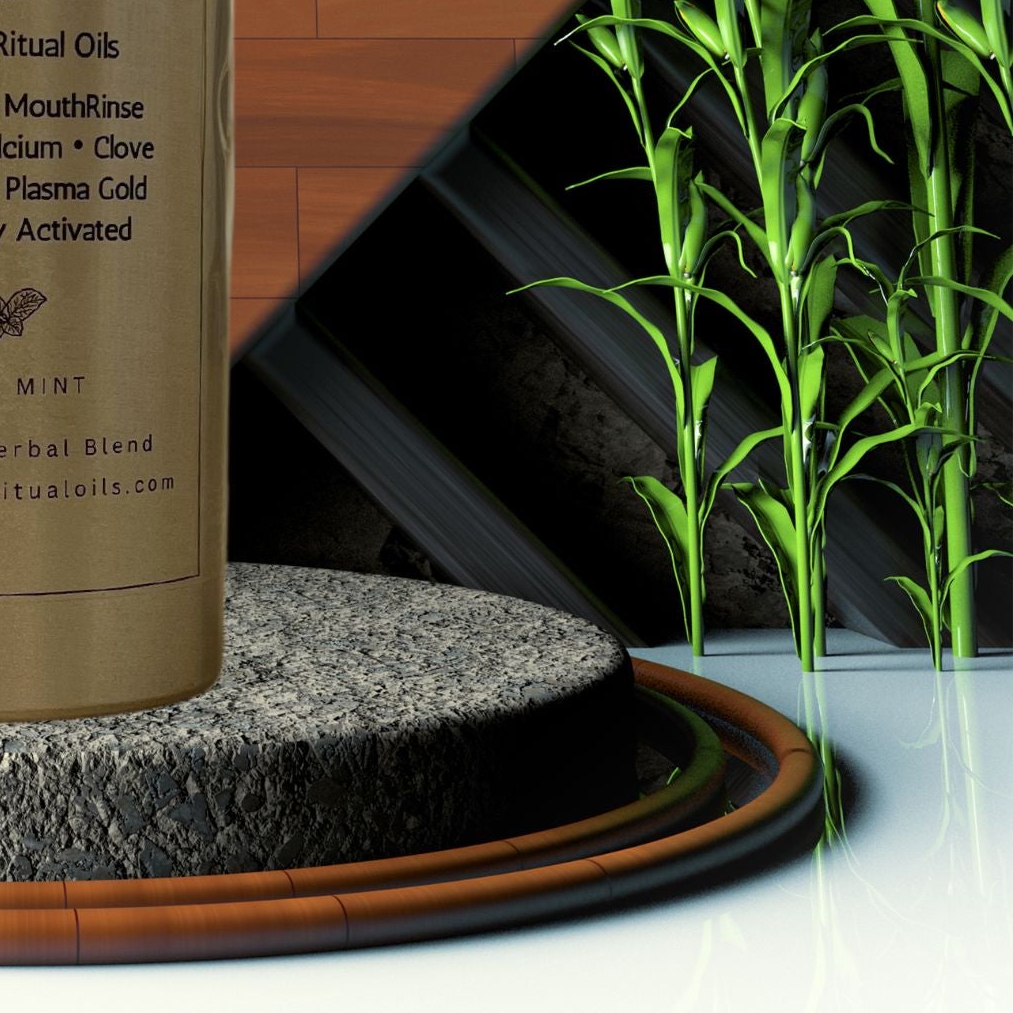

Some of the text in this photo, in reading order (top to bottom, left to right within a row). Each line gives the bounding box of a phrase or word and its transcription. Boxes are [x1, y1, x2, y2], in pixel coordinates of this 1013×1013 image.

[74, 32, 120, 59] Oils
[5, 93, 144, 119] MouthRinse
[94, 135, 155, 159] Clove
[6, 176, 90, 200] Plasma
[98, 175, 147, 200] Gold
[16, 217, 132, 241] Activated
[17, 376, 85, 395] MINT
[85, 434, 153, 456] Blend
